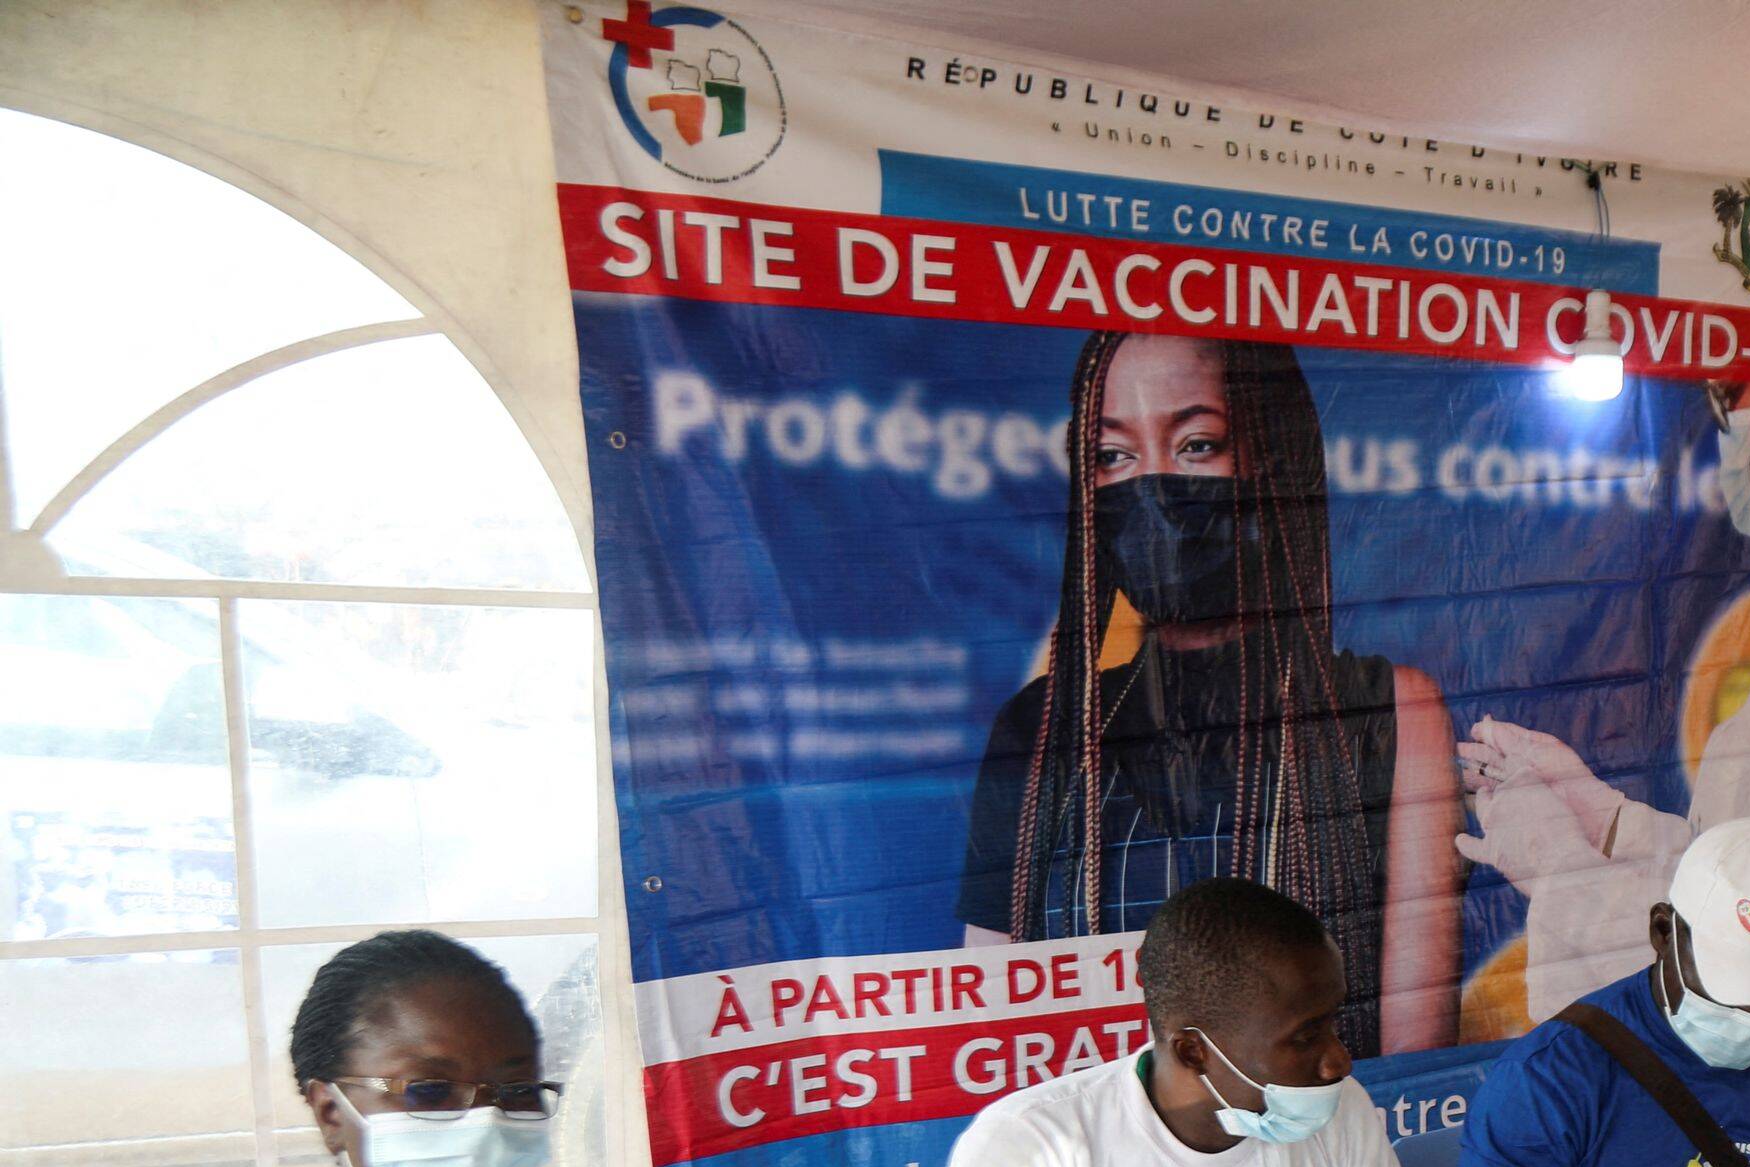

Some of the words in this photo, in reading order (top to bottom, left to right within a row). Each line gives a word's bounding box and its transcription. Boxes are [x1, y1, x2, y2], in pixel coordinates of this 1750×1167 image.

[1086, 122, 1174, 149] Union
[1226, 141, 1376, 175] Discipline
[1424, 166, 1518, 194] Travail
[600, 200, 802, 291] SITE
[838, 226, 958, 304] DE
[994, 240, 1521, 350] VACCINATION
[1019, 187, 1151, 231] LUTTE
[1173, 204, 1328, 249] CONTRE
[1349, 225, 1392, 255] LA
[1410, 229, 1566, 276] COVID-19
[1328, 435, 1421, 495] us
[1438, 443, 1662, 511] contre
[708, 974, 754, 1039] À
[770, 963, 988, 1027] PARTIR
[1007, 952, 1082, 1004] DE
[1103, 948, 1146, 992] 1
[718, 1043, 928, 1129] C'EST
[953, 1018, 1155, 1096] GRAT
[1374, 1093, 1467, 1137] tre
